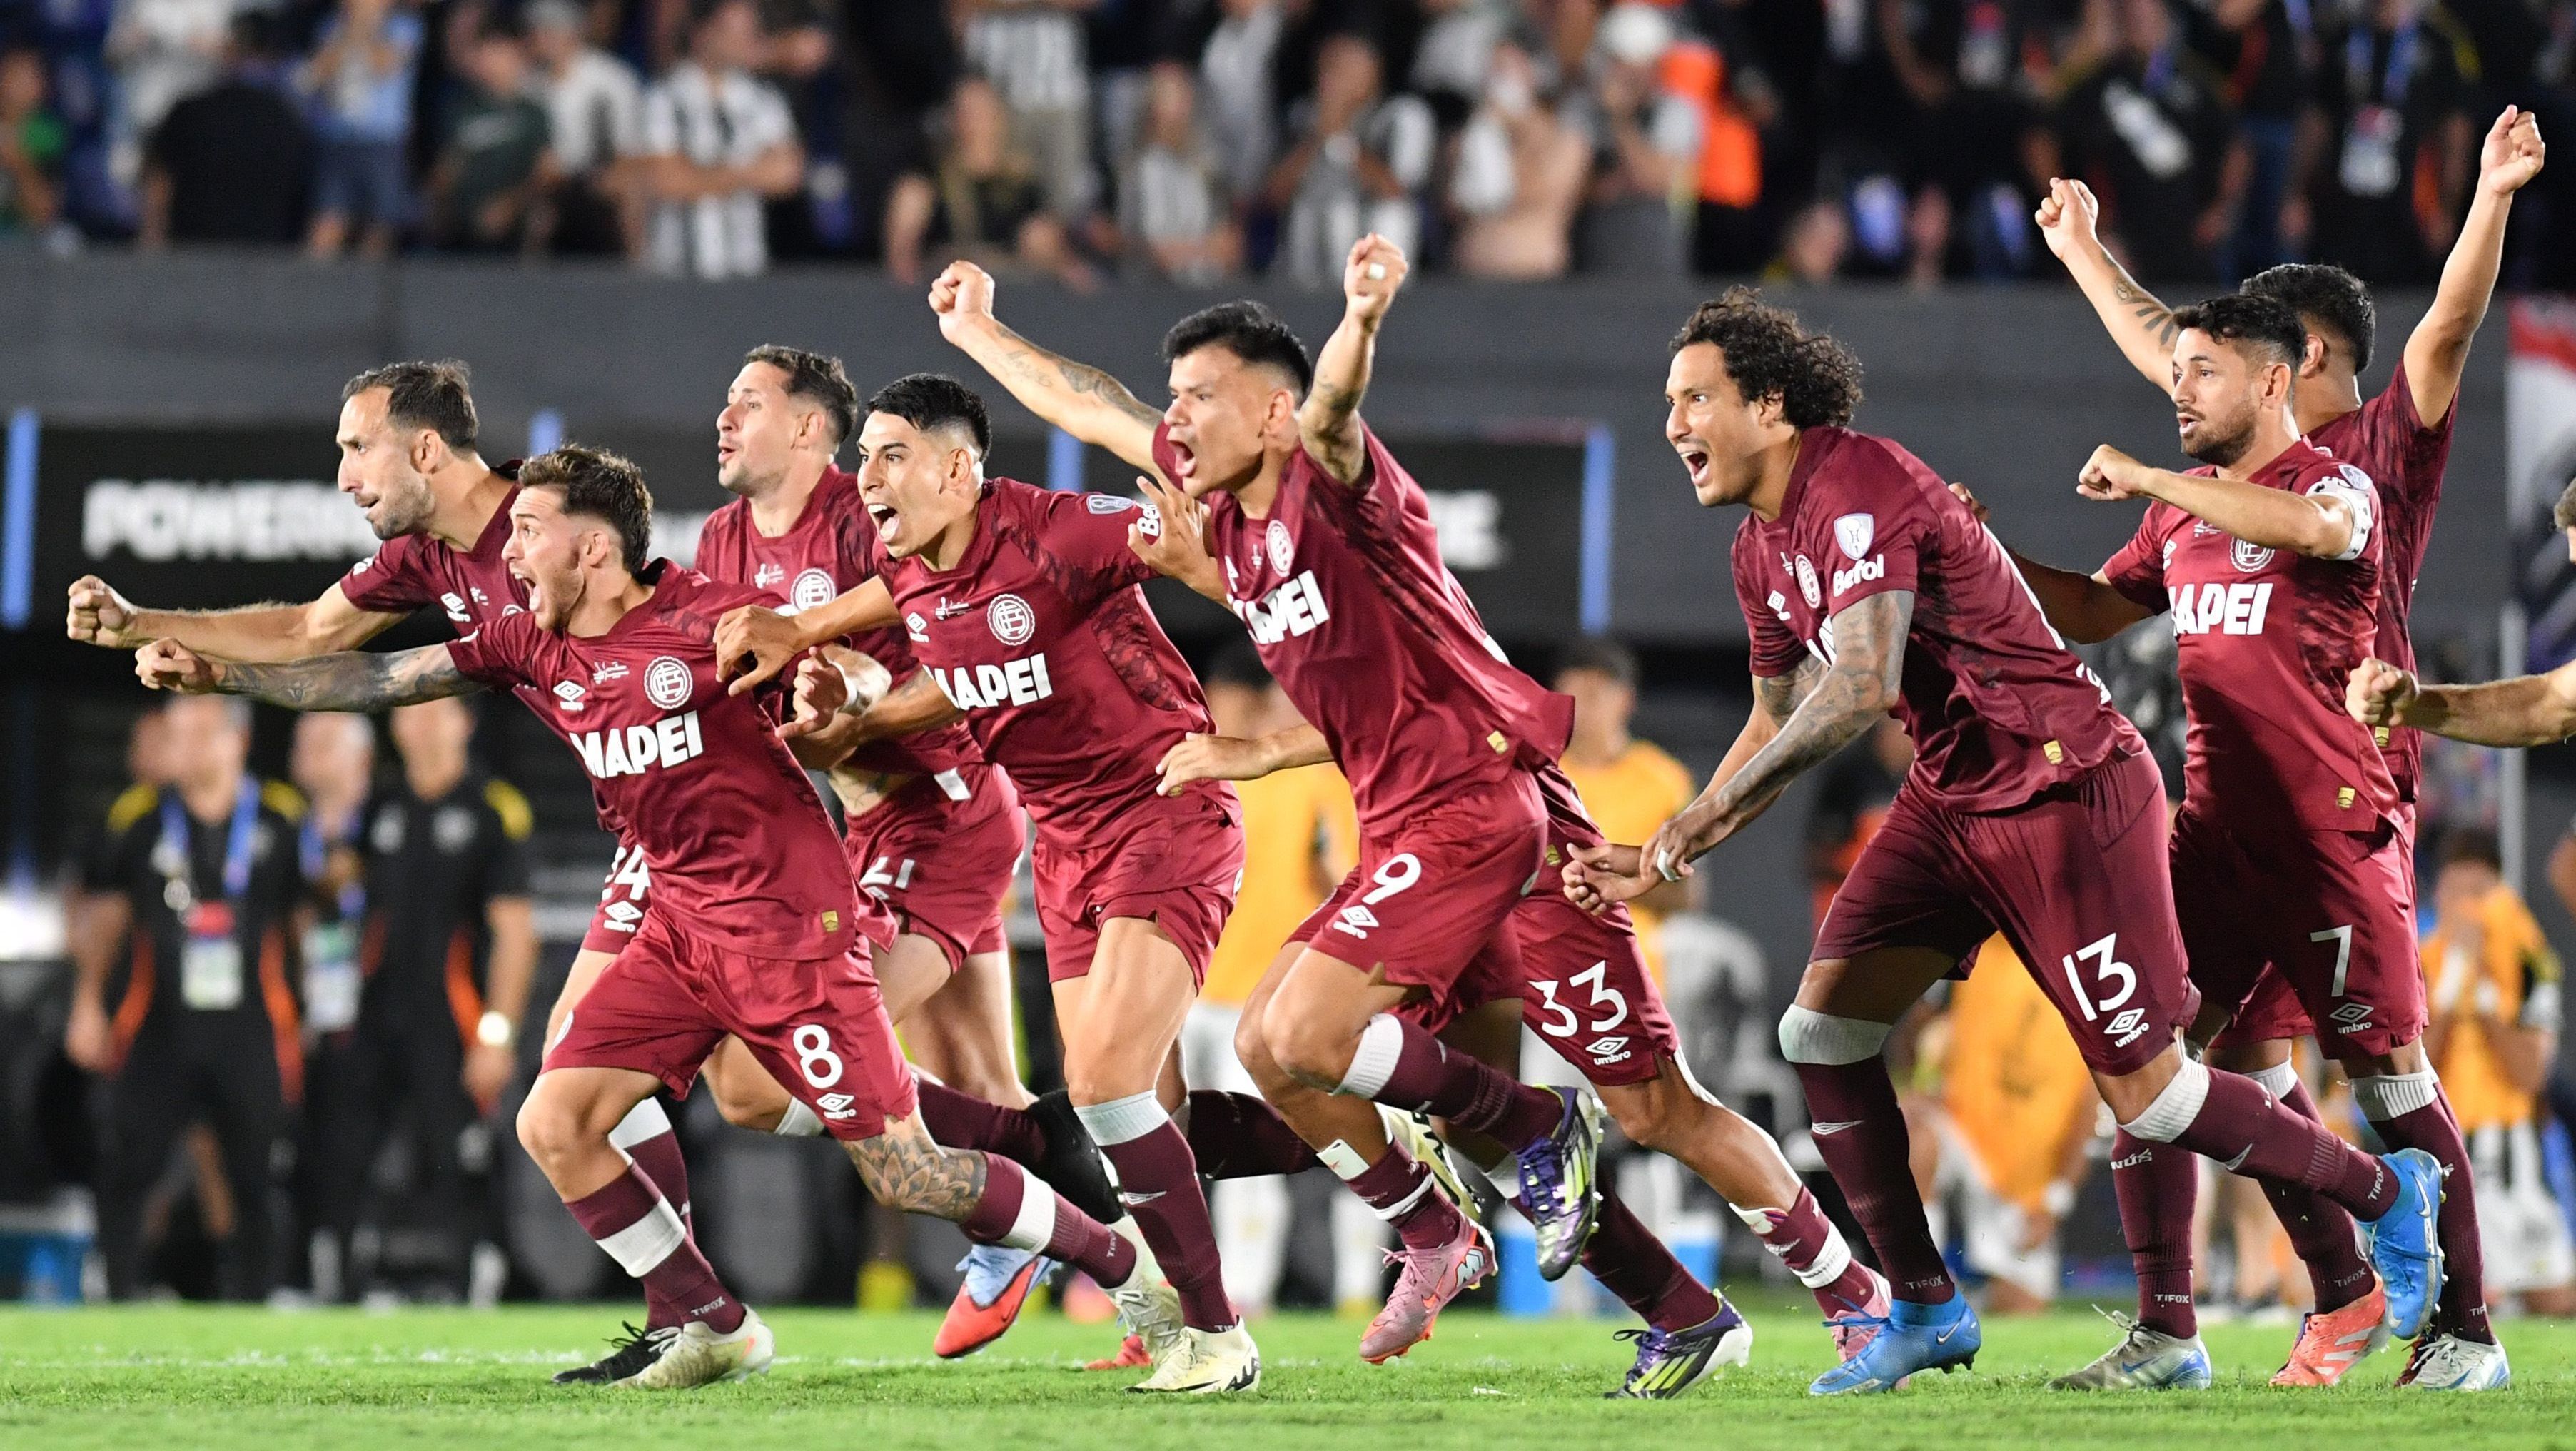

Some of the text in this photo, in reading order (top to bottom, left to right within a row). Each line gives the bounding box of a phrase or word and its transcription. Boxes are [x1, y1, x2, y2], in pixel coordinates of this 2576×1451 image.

[1833, 553, 1884, 597] Befol
[1361, 852, 1422, 905] 9
[2062, 931, 2137, 1022] 13
[2310, 924, 2353, 997] 7
[1527, 959, 1628, 1038] 33
[792, 1023, 843, 1089] 8
[2115, 1022, 2150, 1048] umbro
[1593, 1050, 1632, 1066] umbro
[2368, 1163, 2385, 1201] TIFOX
[690, 1295, 726, 1315] TIFOX
[2154, 1293, 2190, 1304] TIFOX
